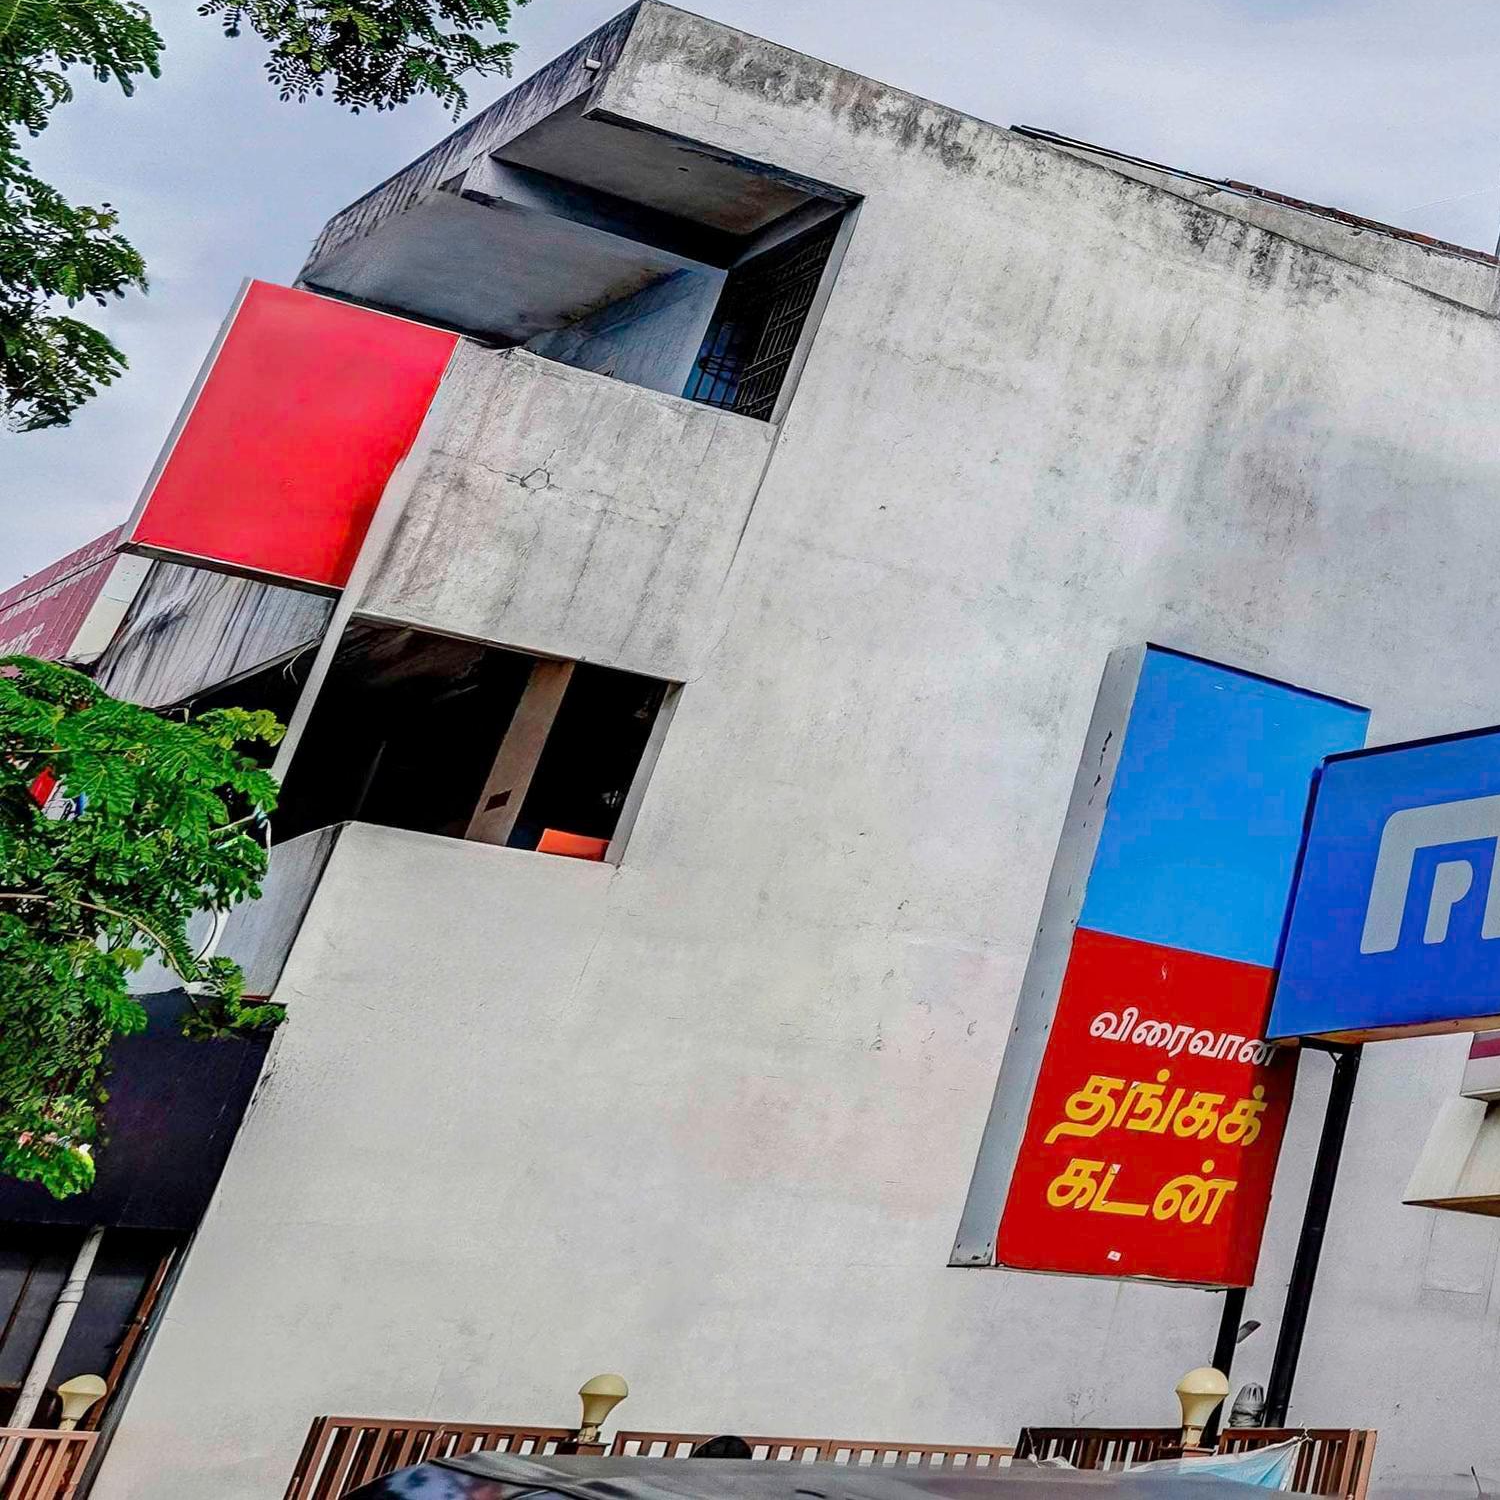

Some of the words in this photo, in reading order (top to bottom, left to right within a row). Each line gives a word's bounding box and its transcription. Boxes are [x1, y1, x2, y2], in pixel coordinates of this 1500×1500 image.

[1089, 1006, 1280, 1067] விரைவான
[1043, 1068, 1268, 1147] தங்கக்
[1046, 1159, 1238, 1225] கடன்
